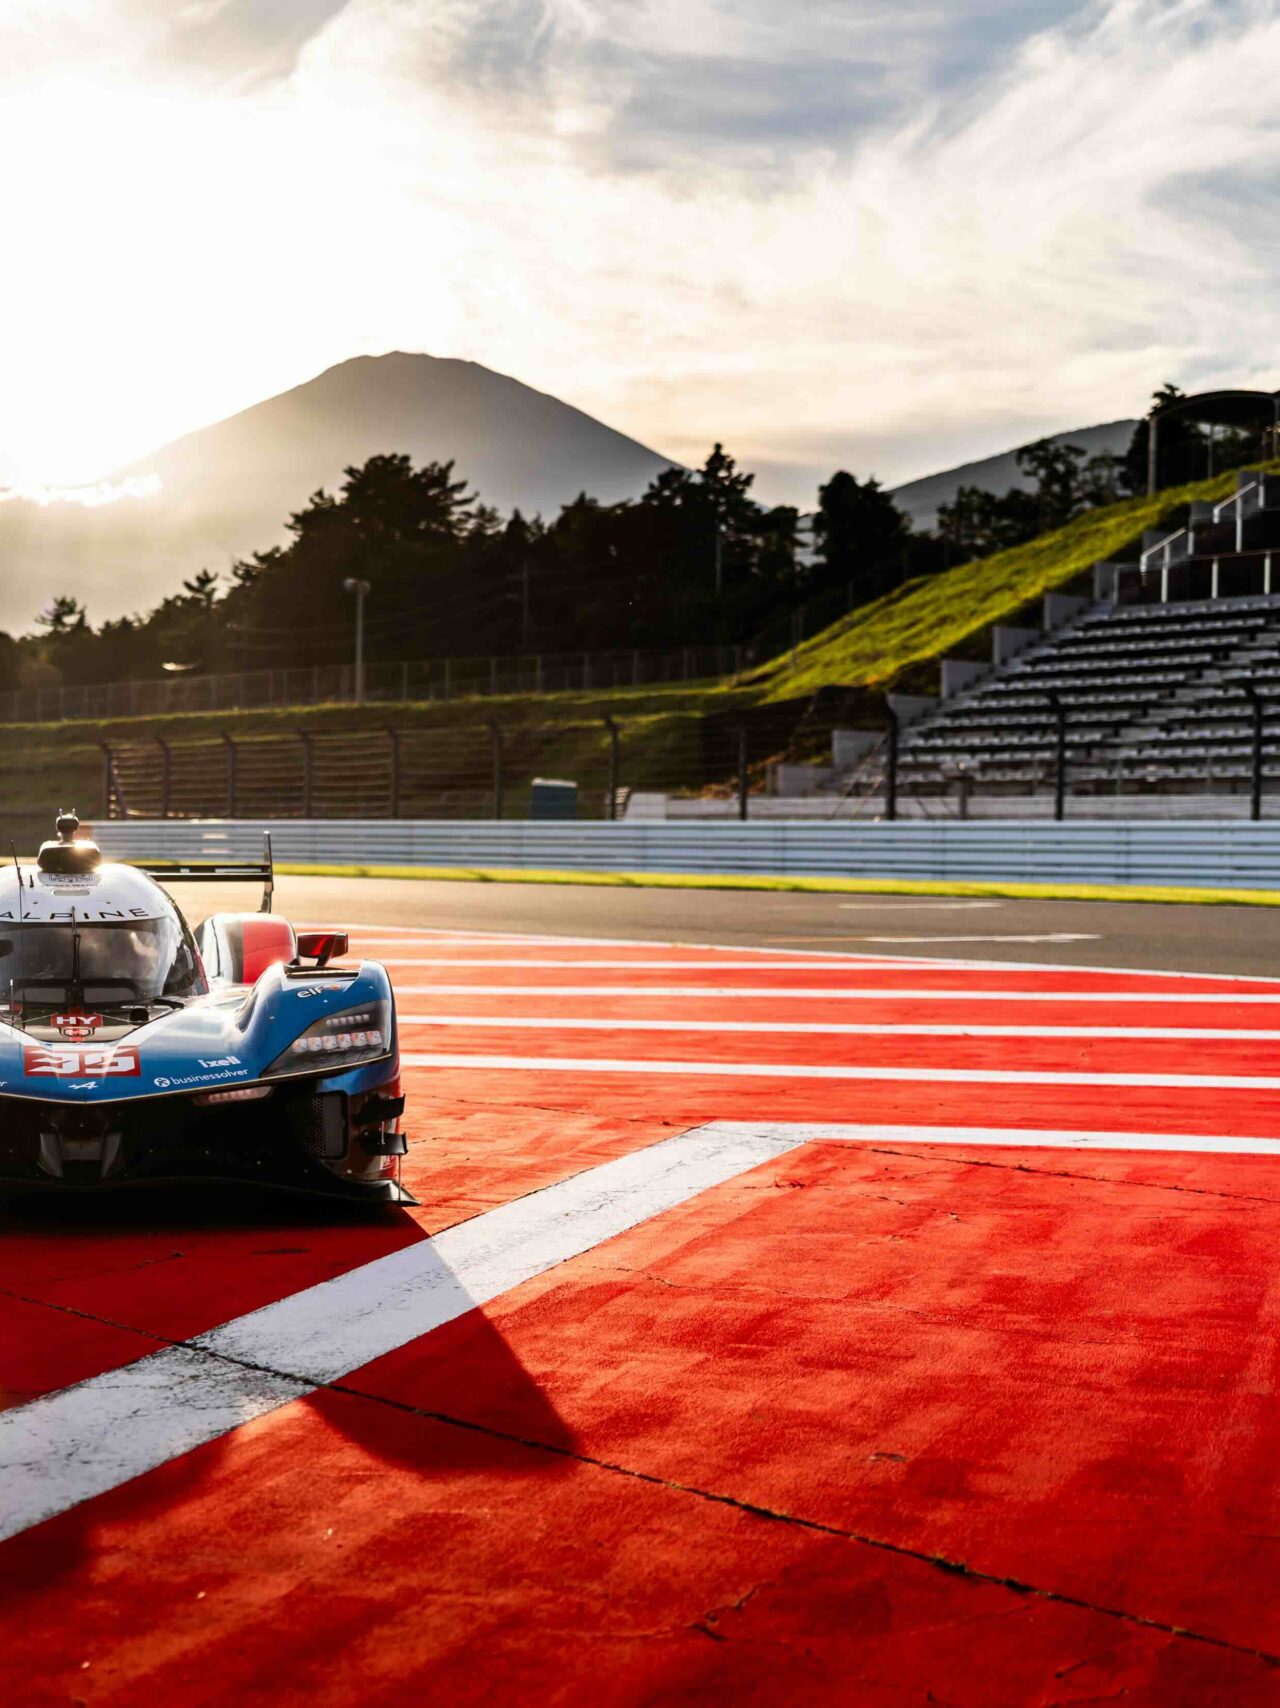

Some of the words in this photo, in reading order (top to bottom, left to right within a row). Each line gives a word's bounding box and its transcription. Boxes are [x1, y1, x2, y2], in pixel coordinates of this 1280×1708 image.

[297, 985, 330, 998] elf
[56, 1016, 97, 1025] HY
[28, 1048, 136, 1074] 35
[197, 1055, 241, 1069] ixell
[170, 1068, 249, 1086] businessolver
